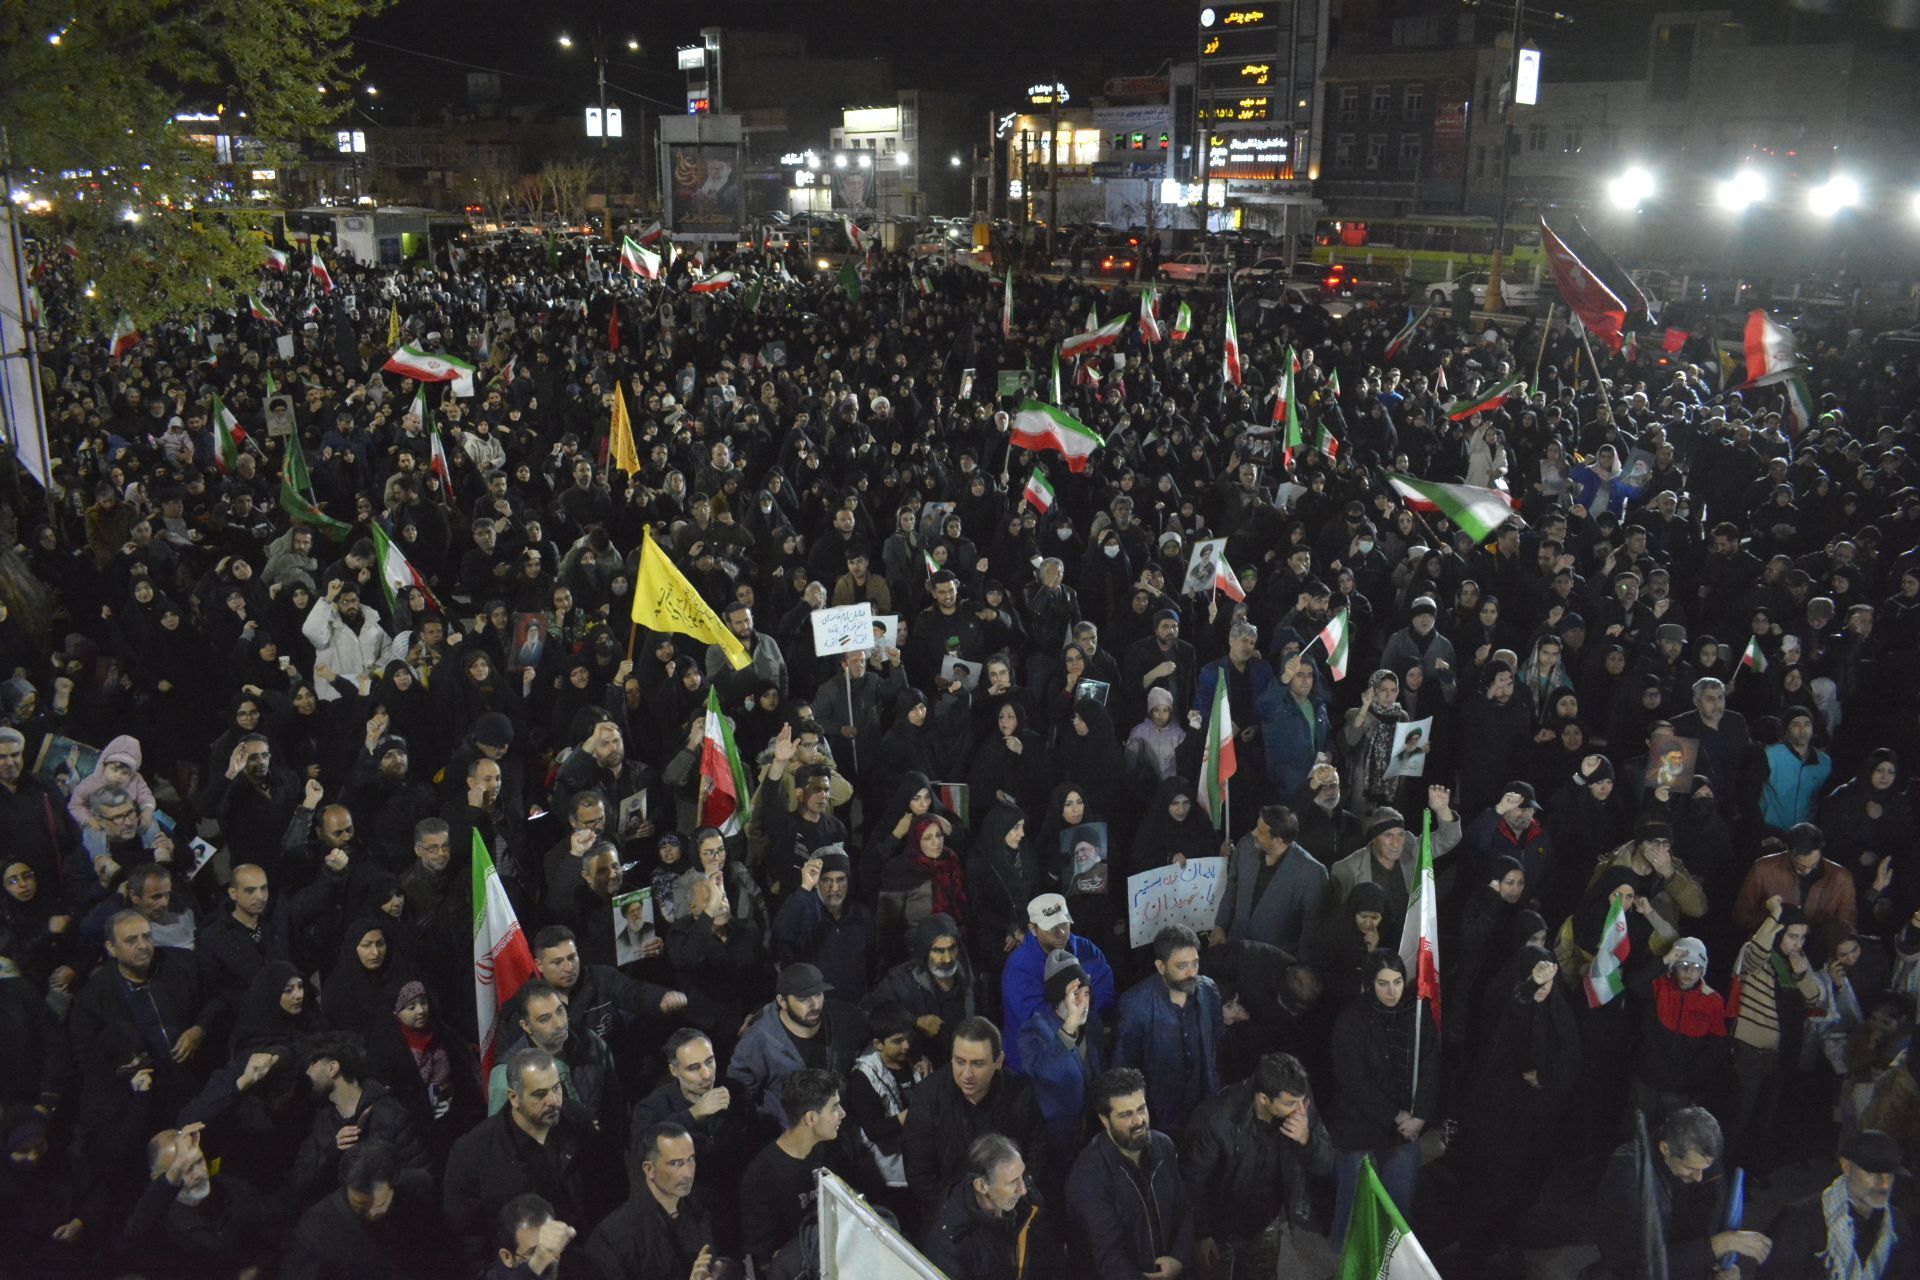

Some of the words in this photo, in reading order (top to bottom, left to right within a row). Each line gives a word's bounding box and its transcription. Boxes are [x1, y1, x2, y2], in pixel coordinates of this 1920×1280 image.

[1204, 37, 1220, 54] نور
[1180, 862, 1216, 882] پیمان
[1134, 876, 1162, 908] بستیم
[1206, 883, 1216, 906] با
